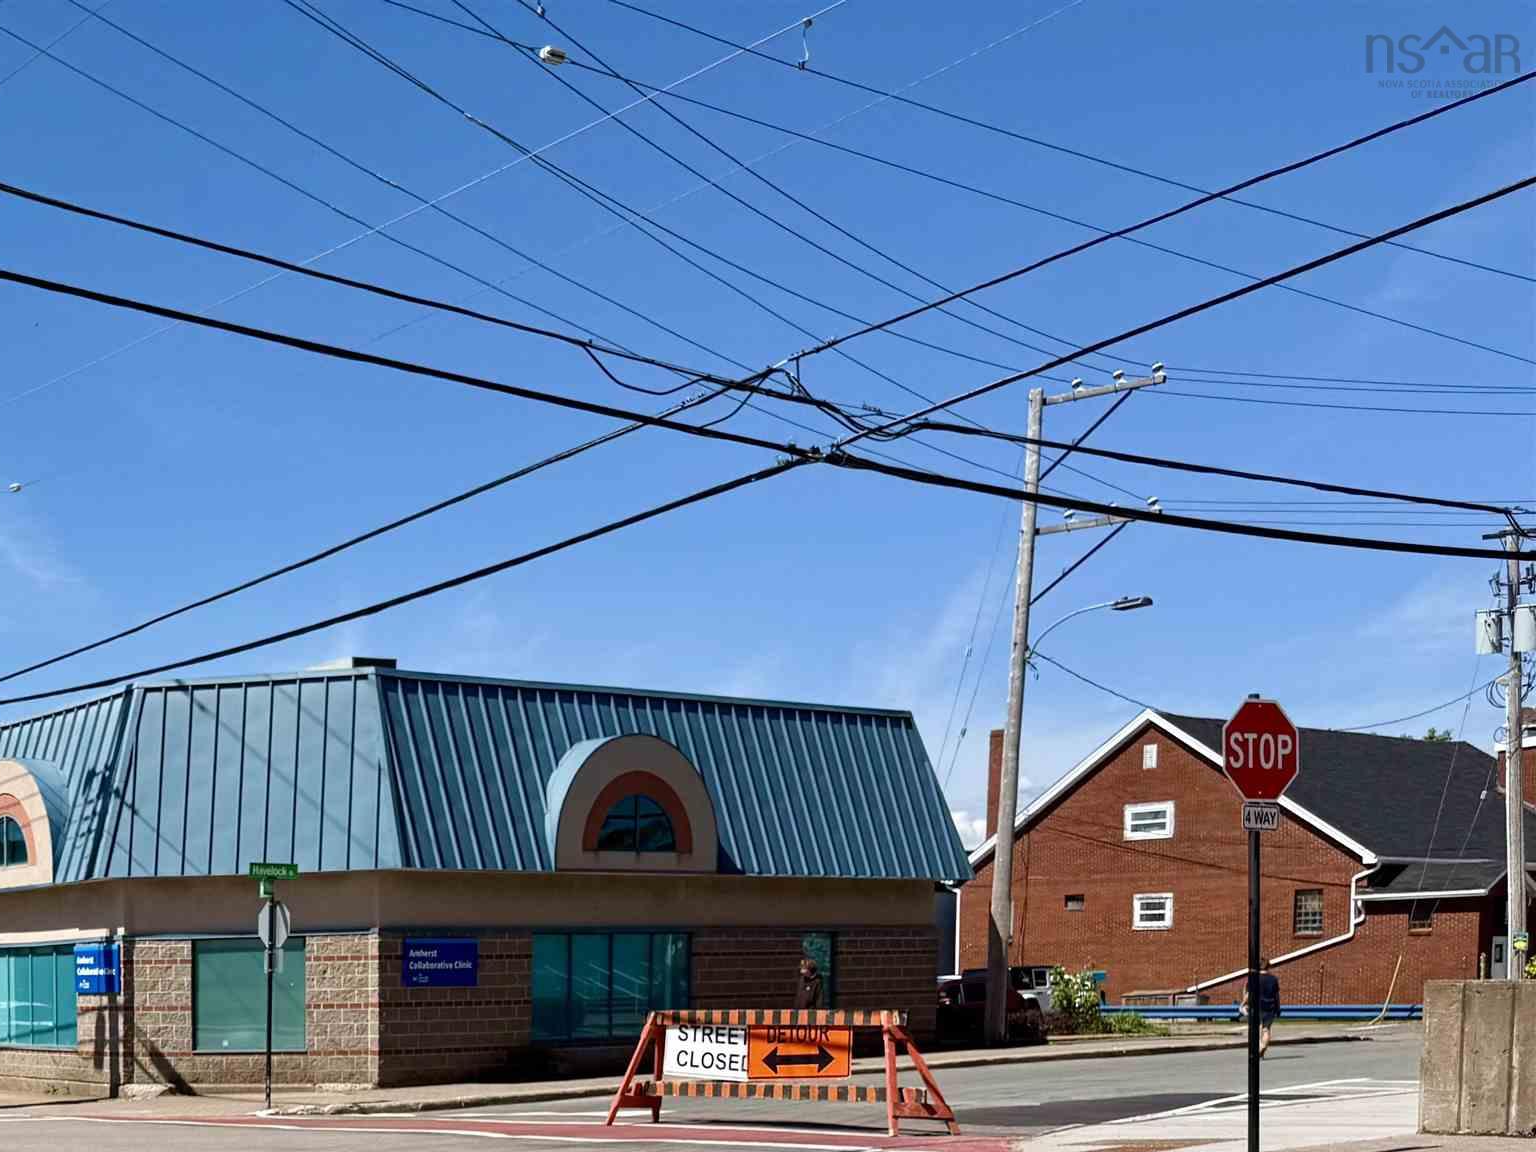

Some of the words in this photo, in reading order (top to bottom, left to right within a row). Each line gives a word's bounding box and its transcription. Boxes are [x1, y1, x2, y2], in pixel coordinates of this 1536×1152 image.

[1228, 731, 1293, 770] STOP
[1245, 806, 1252, 823] 4
[1253, 806, 1277, 826] WAY
[408, 949, 438, 958] Amherst
[408, 960, 453, 970] Collaborative
[454, 960, 473, 969] Clinic
[678, 1025, 747, 1045] STREET
[767, 1025, 830, 1044] DETOUR
